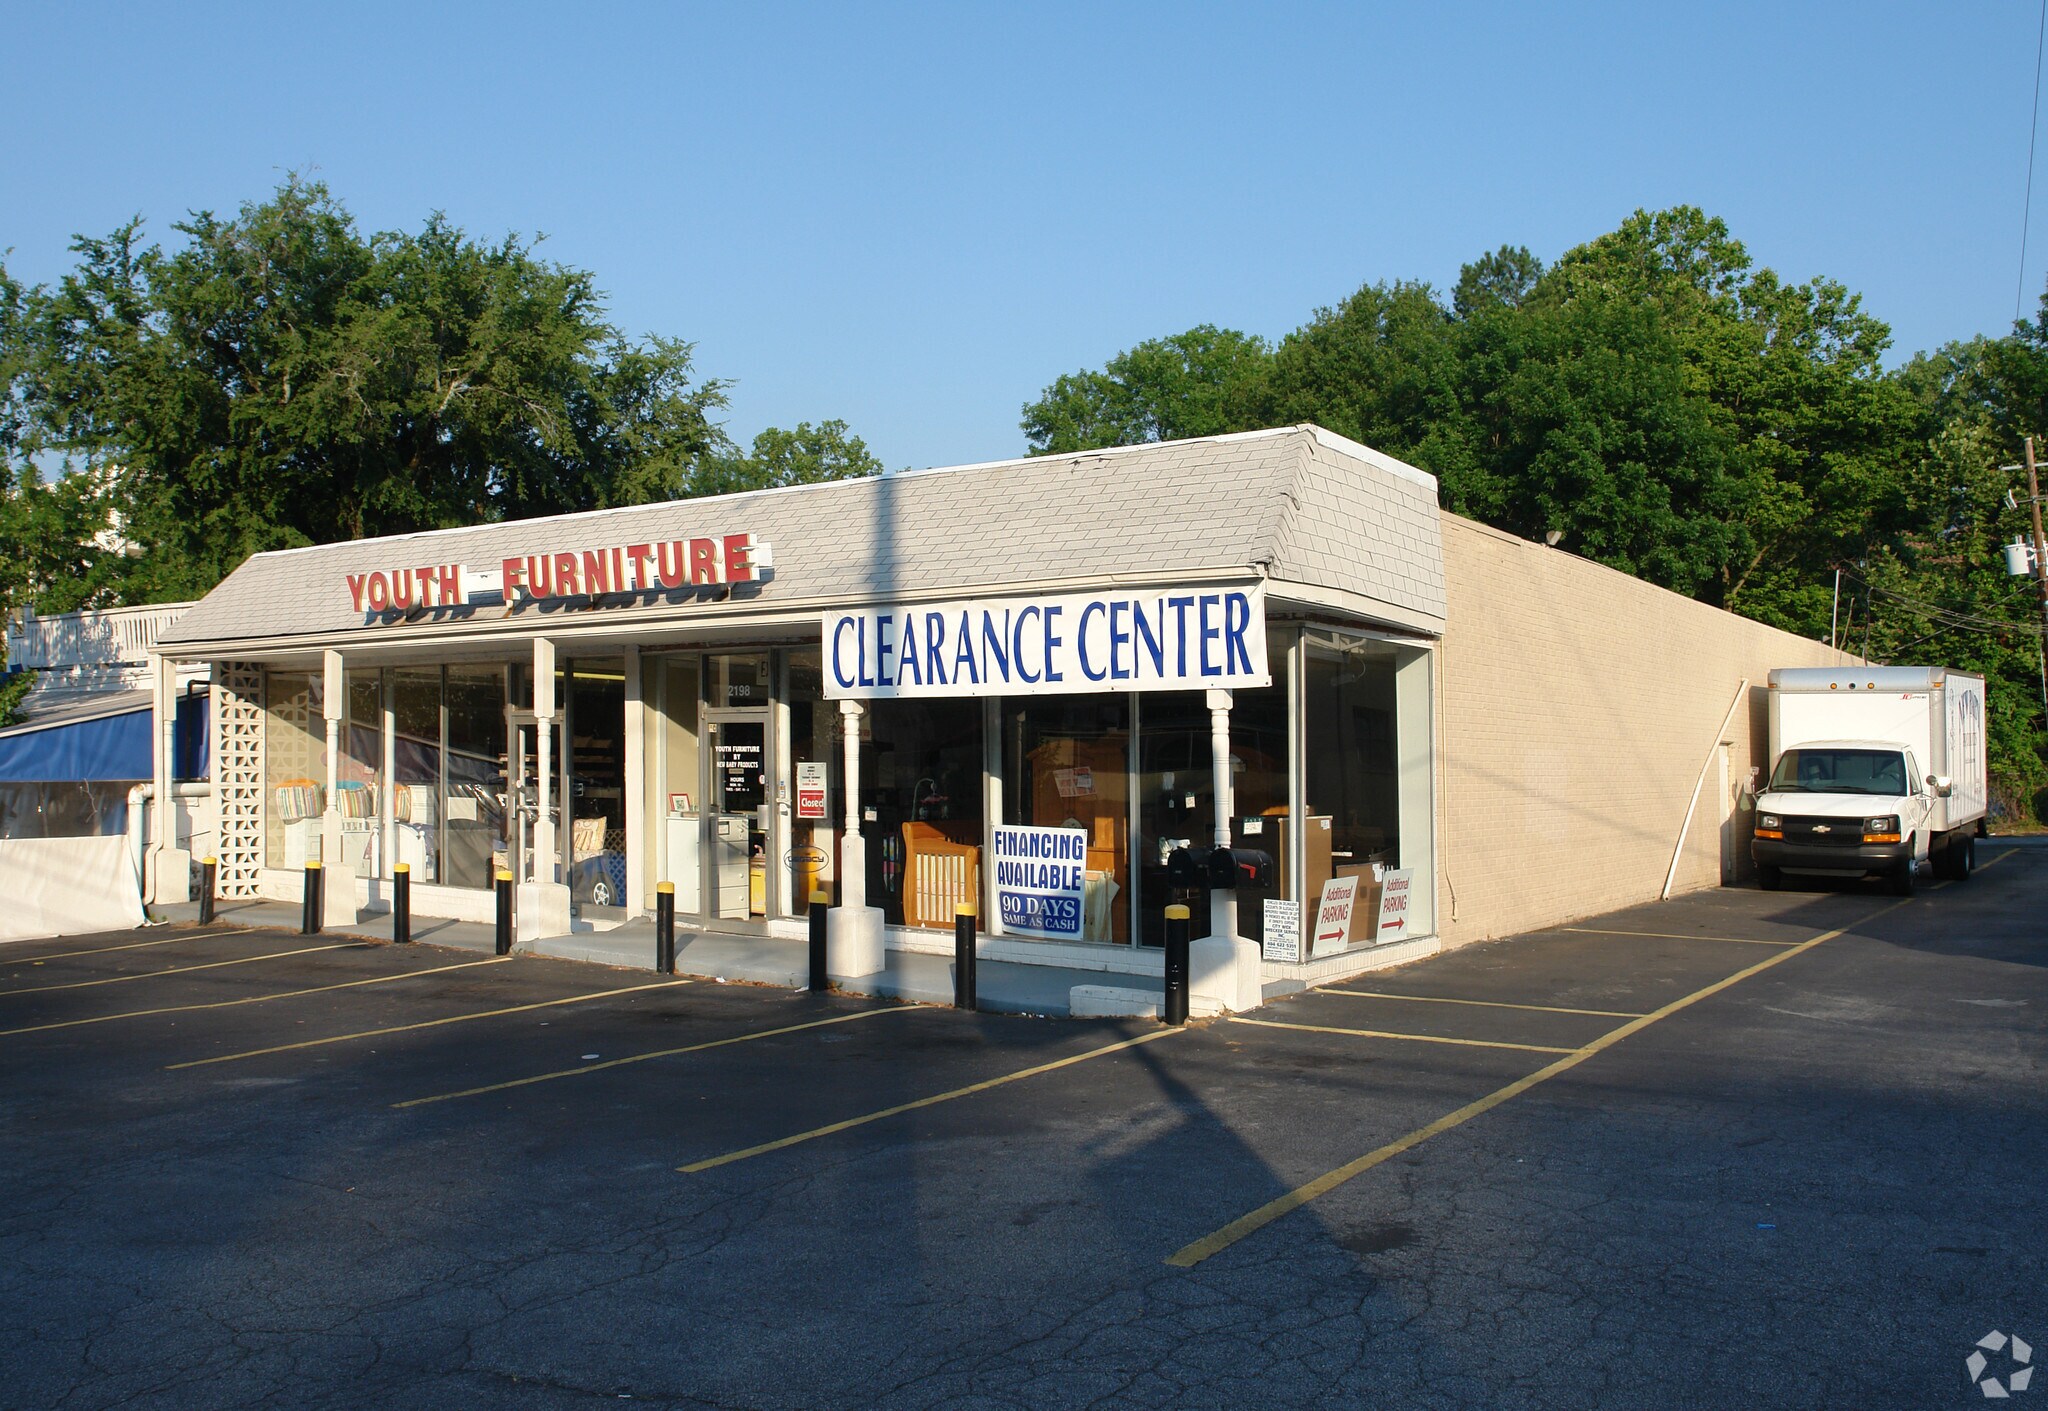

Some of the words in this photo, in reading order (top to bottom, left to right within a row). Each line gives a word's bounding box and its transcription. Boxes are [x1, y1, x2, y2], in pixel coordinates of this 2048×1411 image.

[346, 564, 462, 613] YOUTH
[502, 533, 755, 600] FURNITURE
[832, 605, 1062, 688] CLEARANCE
[1077, 592, 1254, 682] CENTER
[728, 684, 751, 697] 2198
[801, 797, 824, 808] Closed
[995, 831, 1083, 860] FINANCING
[998, 861, 1081, 891] AVAILABLE
[1386, 877, 1410, 892] Additional
[1325, 885, 1353, 902] Additional
[1002, 895, 1022, 914] 90
[1026, 898, 1076, 919] DAYS
[1321, 903, 1349, 924] PARKING
[1383, 894, 1408, 914] PARKING
[1003, 912, 1027, 926] SAME
[1029, 916, 1043, 928] AS
[1045, 917, 1076, 931] CASH
